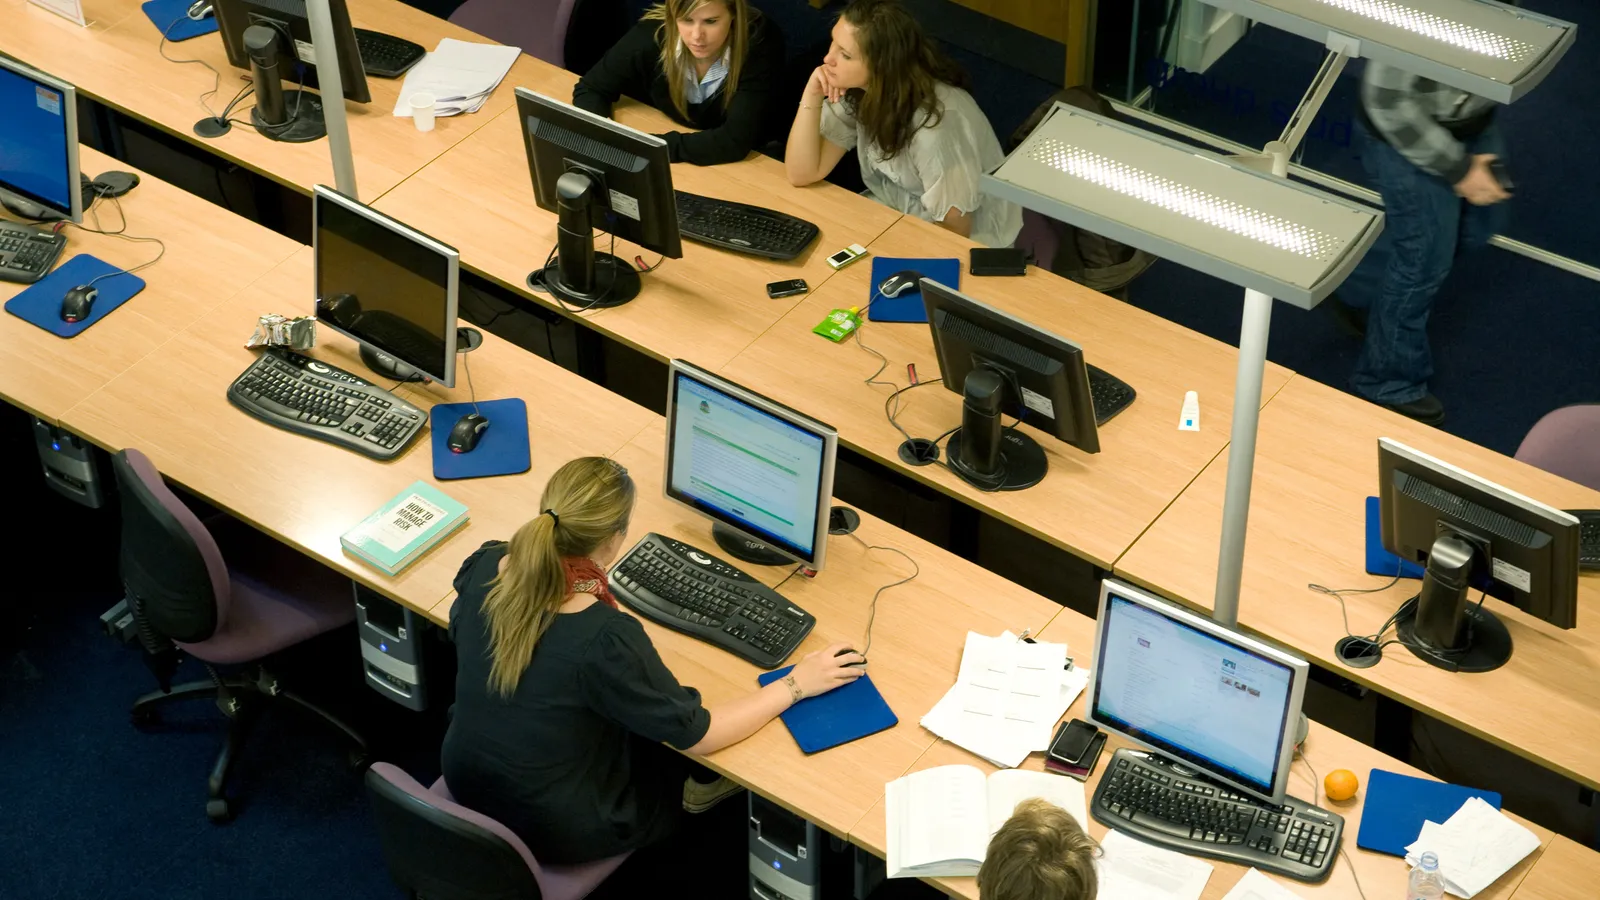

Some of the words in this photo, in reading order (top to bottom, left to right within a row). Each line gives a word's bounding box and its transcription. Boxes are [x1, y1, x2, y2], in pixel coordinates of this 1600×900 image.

[396, 508, 427, 528] MANAGE
[405, 502, 425, 516] HOW
[422, 511, 435, 521] TO
[393, 517, 413, 532] RISK
